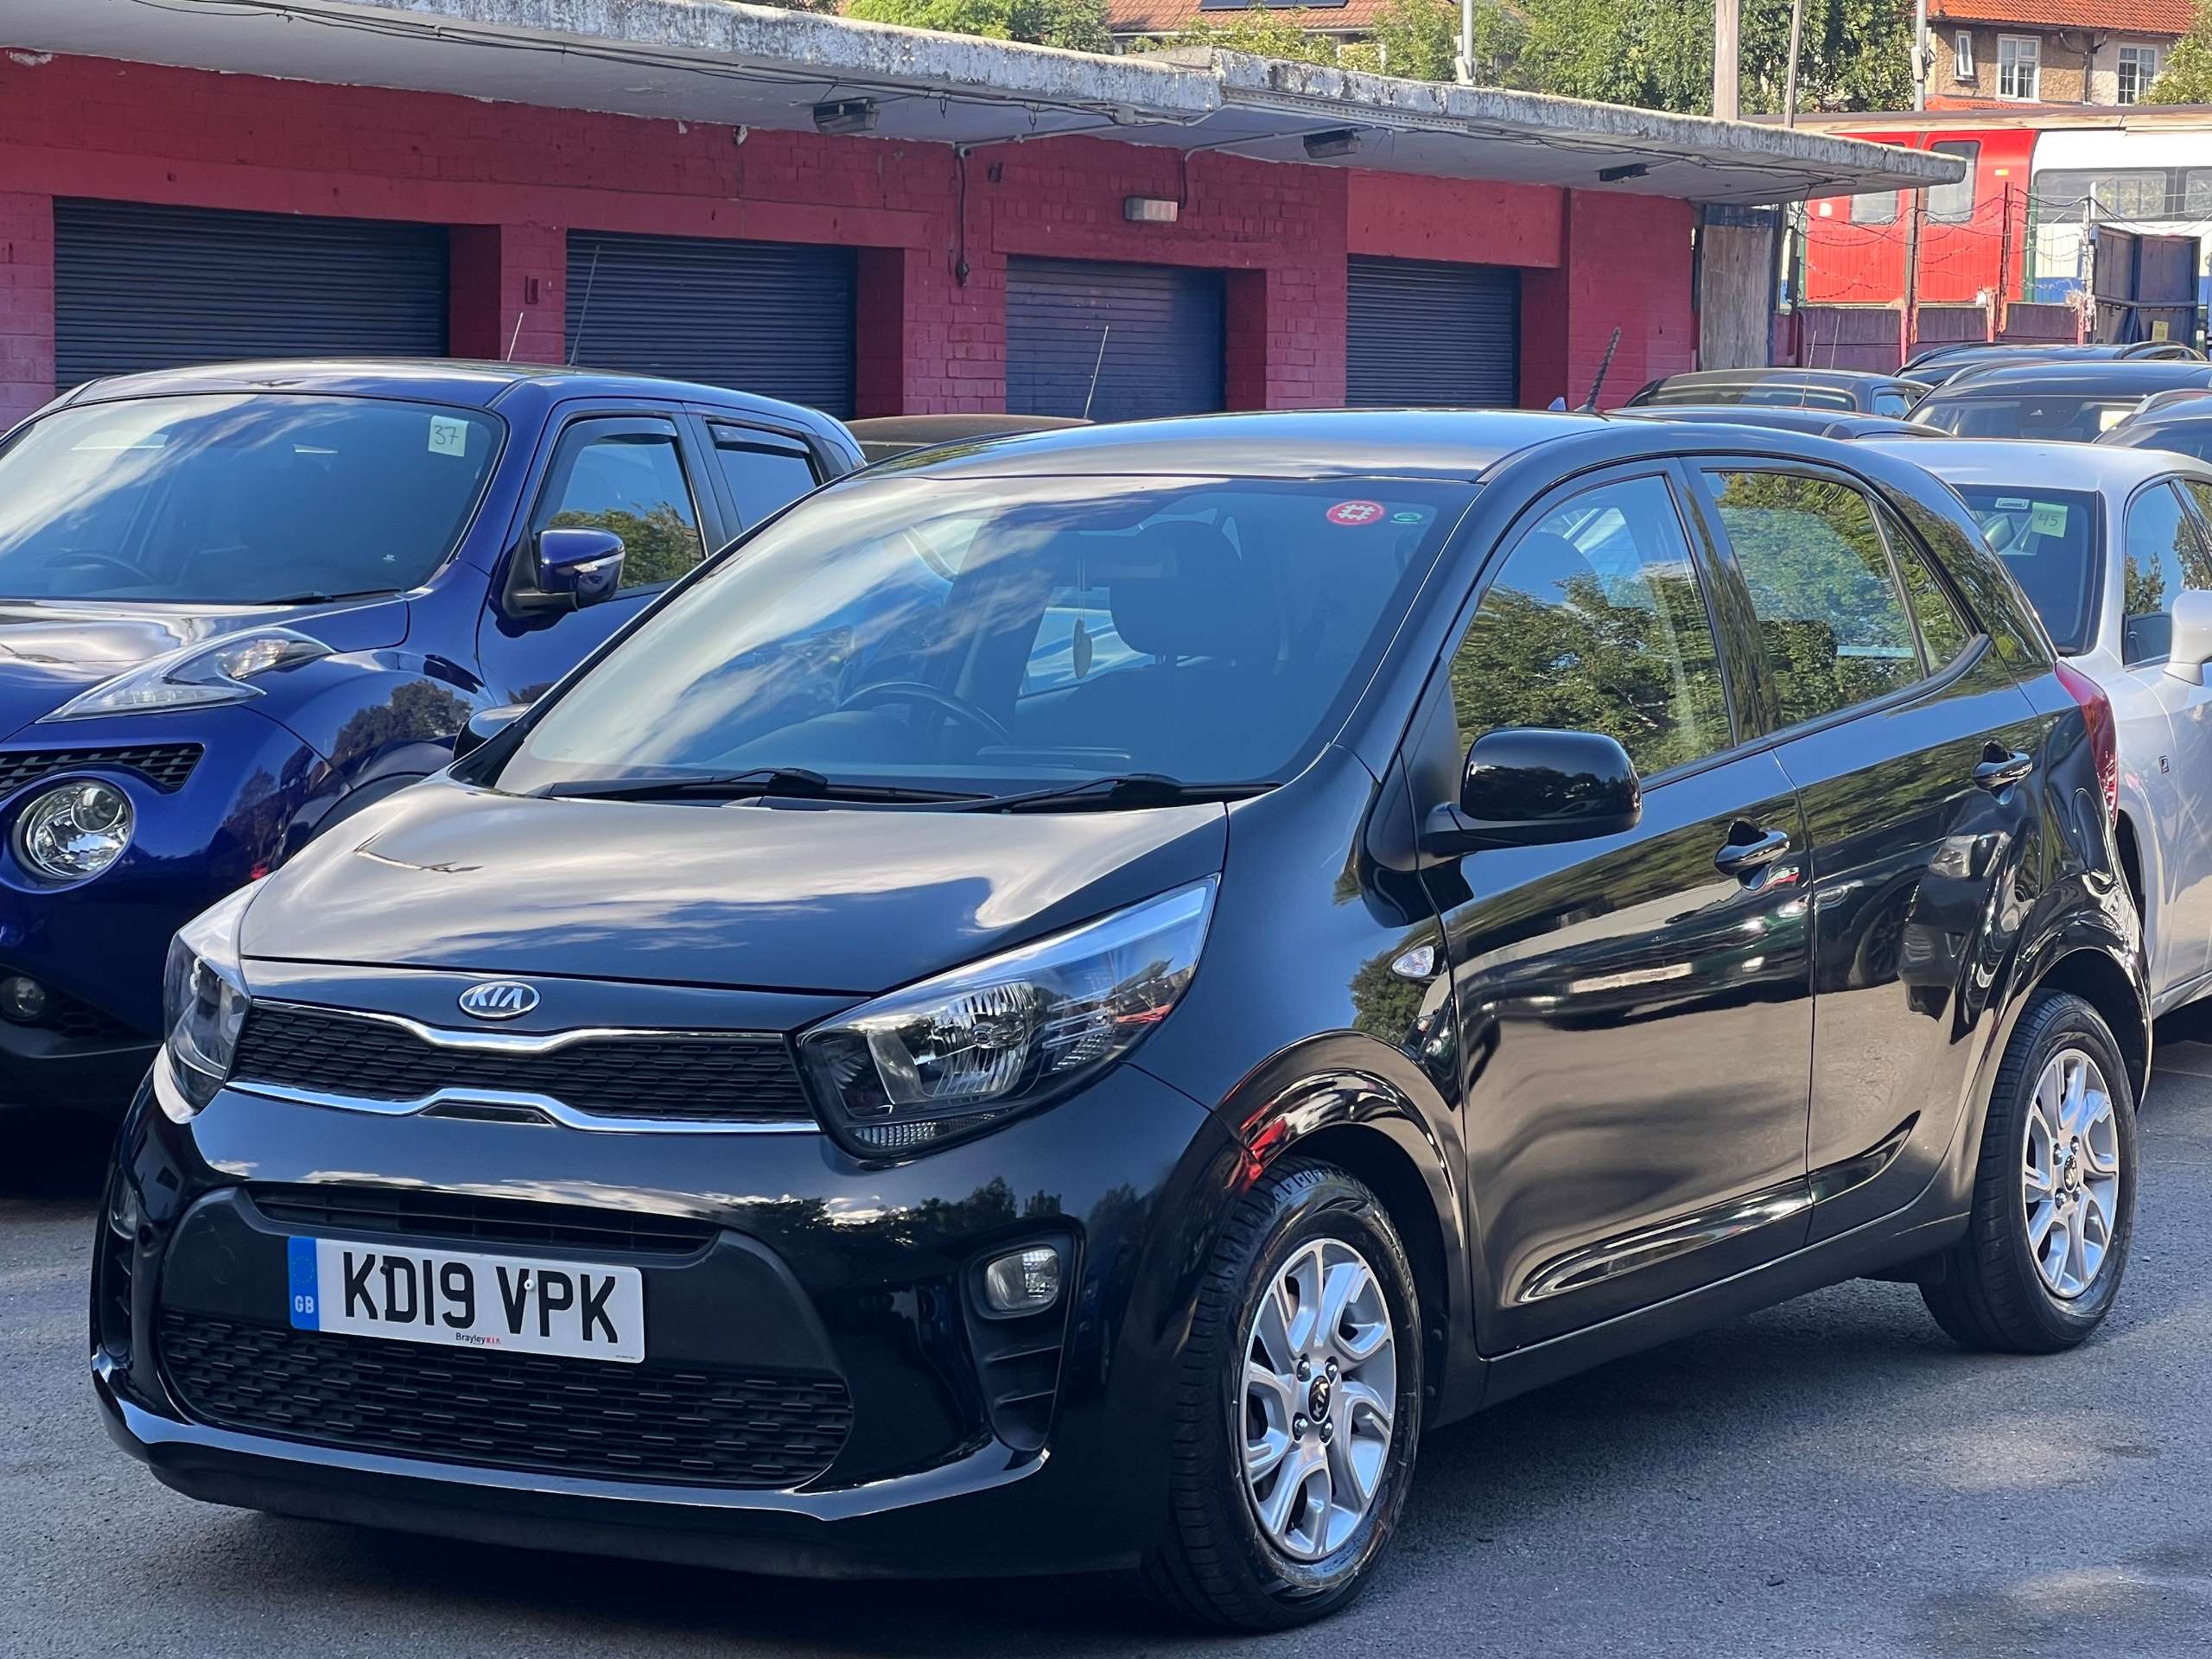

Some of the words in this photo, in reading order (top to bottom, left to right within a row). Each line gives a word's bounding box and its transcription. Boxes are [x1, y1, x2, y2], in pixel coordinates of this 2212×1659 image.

[434, 425, 459, 445] 37
[2038, 512, 2058, 526] 45
[468, 987, 523, 1009] KIA
[295, 1295, 315, 1314] GB
[343, 1251, 474, 1329] KD19
[495, 1266, 618, 1344] VPK
